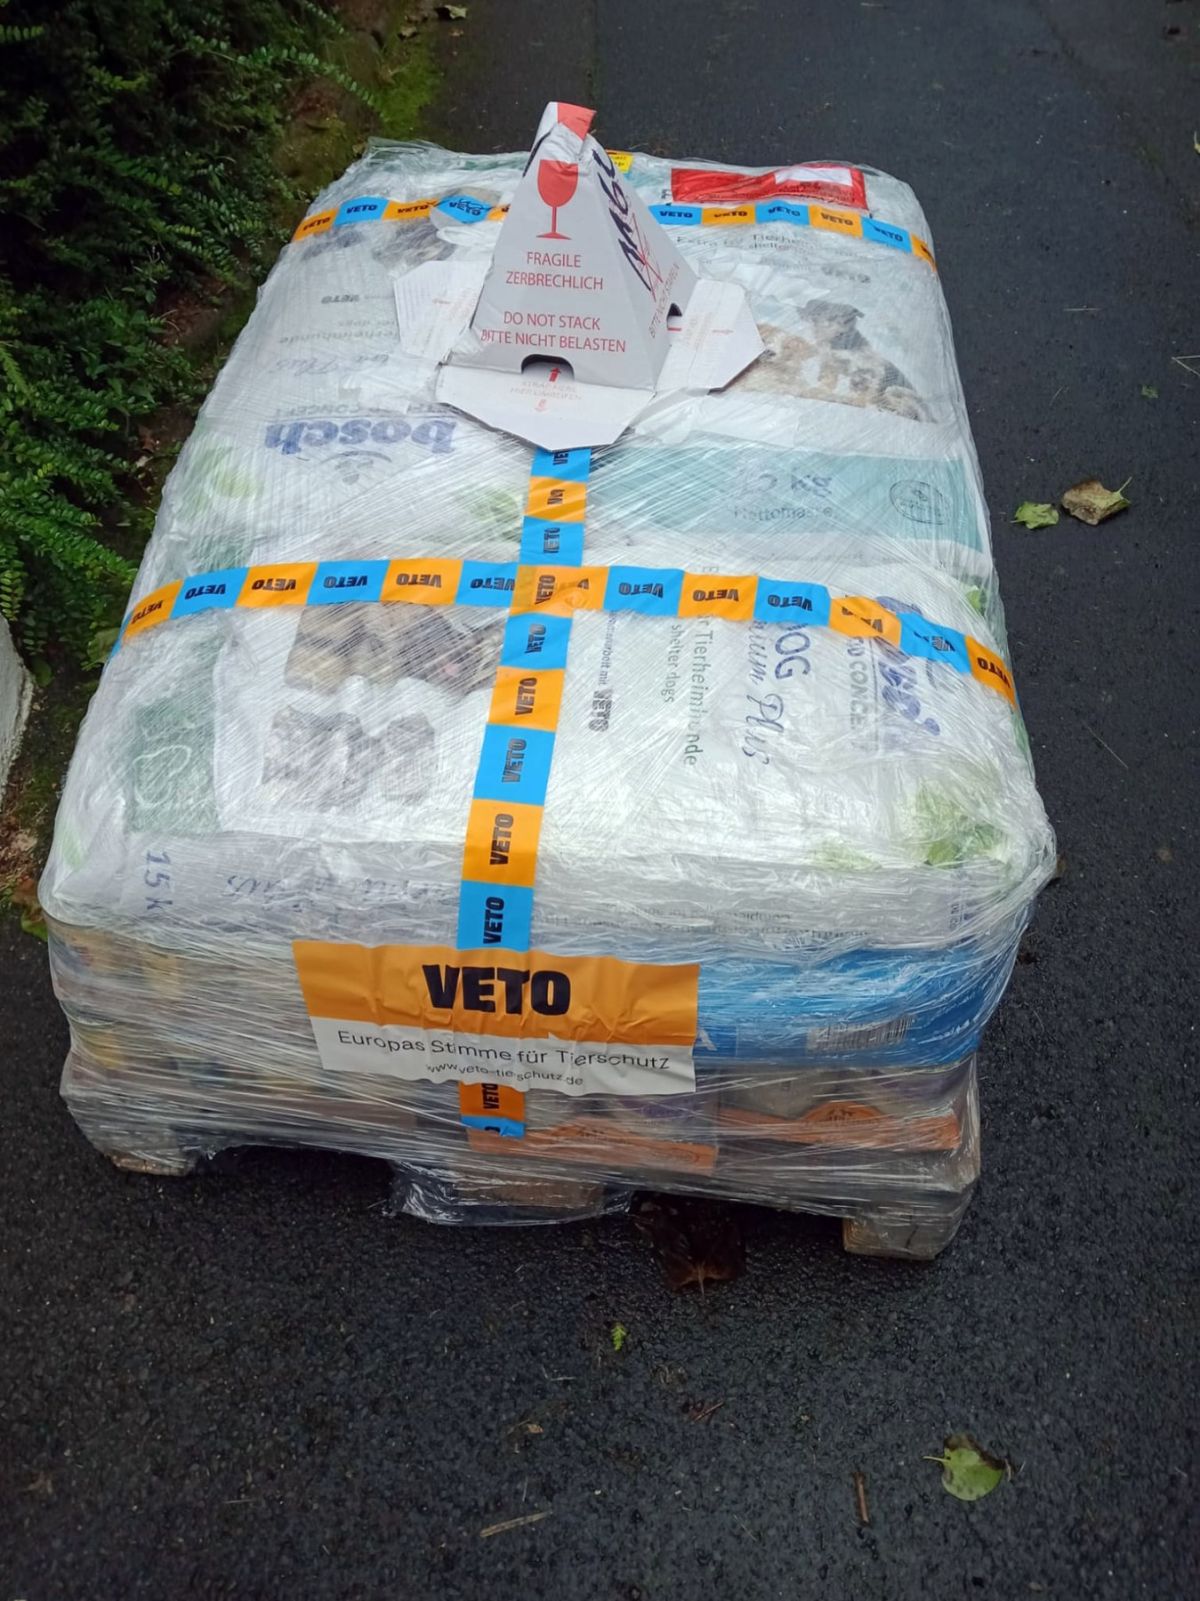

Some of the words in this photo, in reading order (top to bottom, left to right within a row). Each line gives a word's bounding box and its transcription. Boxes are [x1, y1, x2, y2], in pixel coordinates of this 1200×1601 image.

[346, 204, 379, 215] VETO
[660, 210, 693, 219] VETO
[767, 206, 801, 217] VETO
[820, 212, 854, 226] VETO
[526, 252, 582, 268] FRAGILE
[506, 271, 604, 290] ZERBRECHLICH
[504, 311, 523, 325] DO
[527, 314, 556, 328] NOT
[559, 315, 601, 331] STACK
[480, 329, 512, 344] BITTE
[515, 332, 556, 348] NICHT
[559, 336, 626, 352] BELASTEN
[265, 419, 457, 456] bosch
[252, 579, 297, 592] VETO
[323, 575, 368, 588] VETO
[396, 573, 442, 588] VETO
[470, 577, 516, 591] VETO
[185, 584, 226, 599] VETO
[618, 582, 664, 598] VETO
[693, 589, 739, 602] VETO
[767, 594, 813, 611] VETO
[774, 622, 812, 680] OG
[660, 671, 681, 703] dogs
[514, 677, 537, 716] VETO
[741, 692, 786, 765] Plus
[501, 737, 527, 784] VETO
[489, 813, 514, 866] VETO
[482, 896, 505, 944] VETO
[422, 965, 571, 1016] VETO
[338, 1030, 425, 1052] Europas
[431, 1040, 512, 1060] Stimme
[517, 1050, 548, 1064] für
[556, 1050, 671, 1070] Tierschutz
